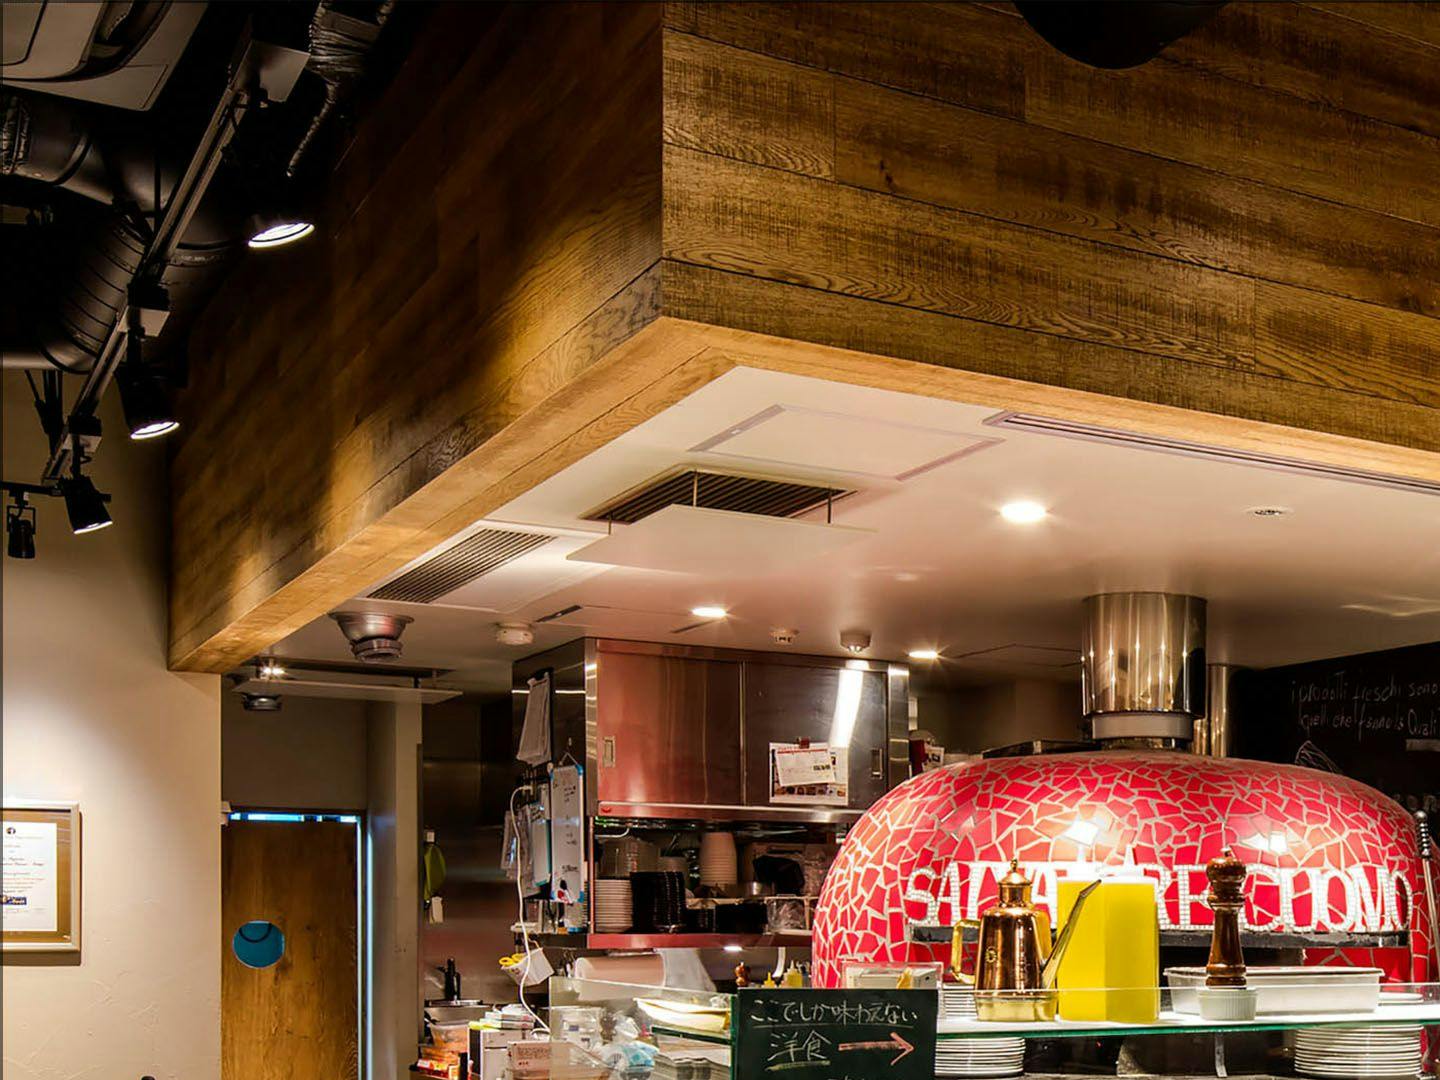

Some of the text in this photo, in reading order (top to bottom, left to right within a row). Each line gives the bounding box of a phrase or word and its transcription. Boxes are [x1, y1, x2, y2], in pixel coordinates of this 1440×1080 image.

[751, 999, 918, 1026] ここでしか味わえない
[767, 1029, 832, 1063] 洋食
